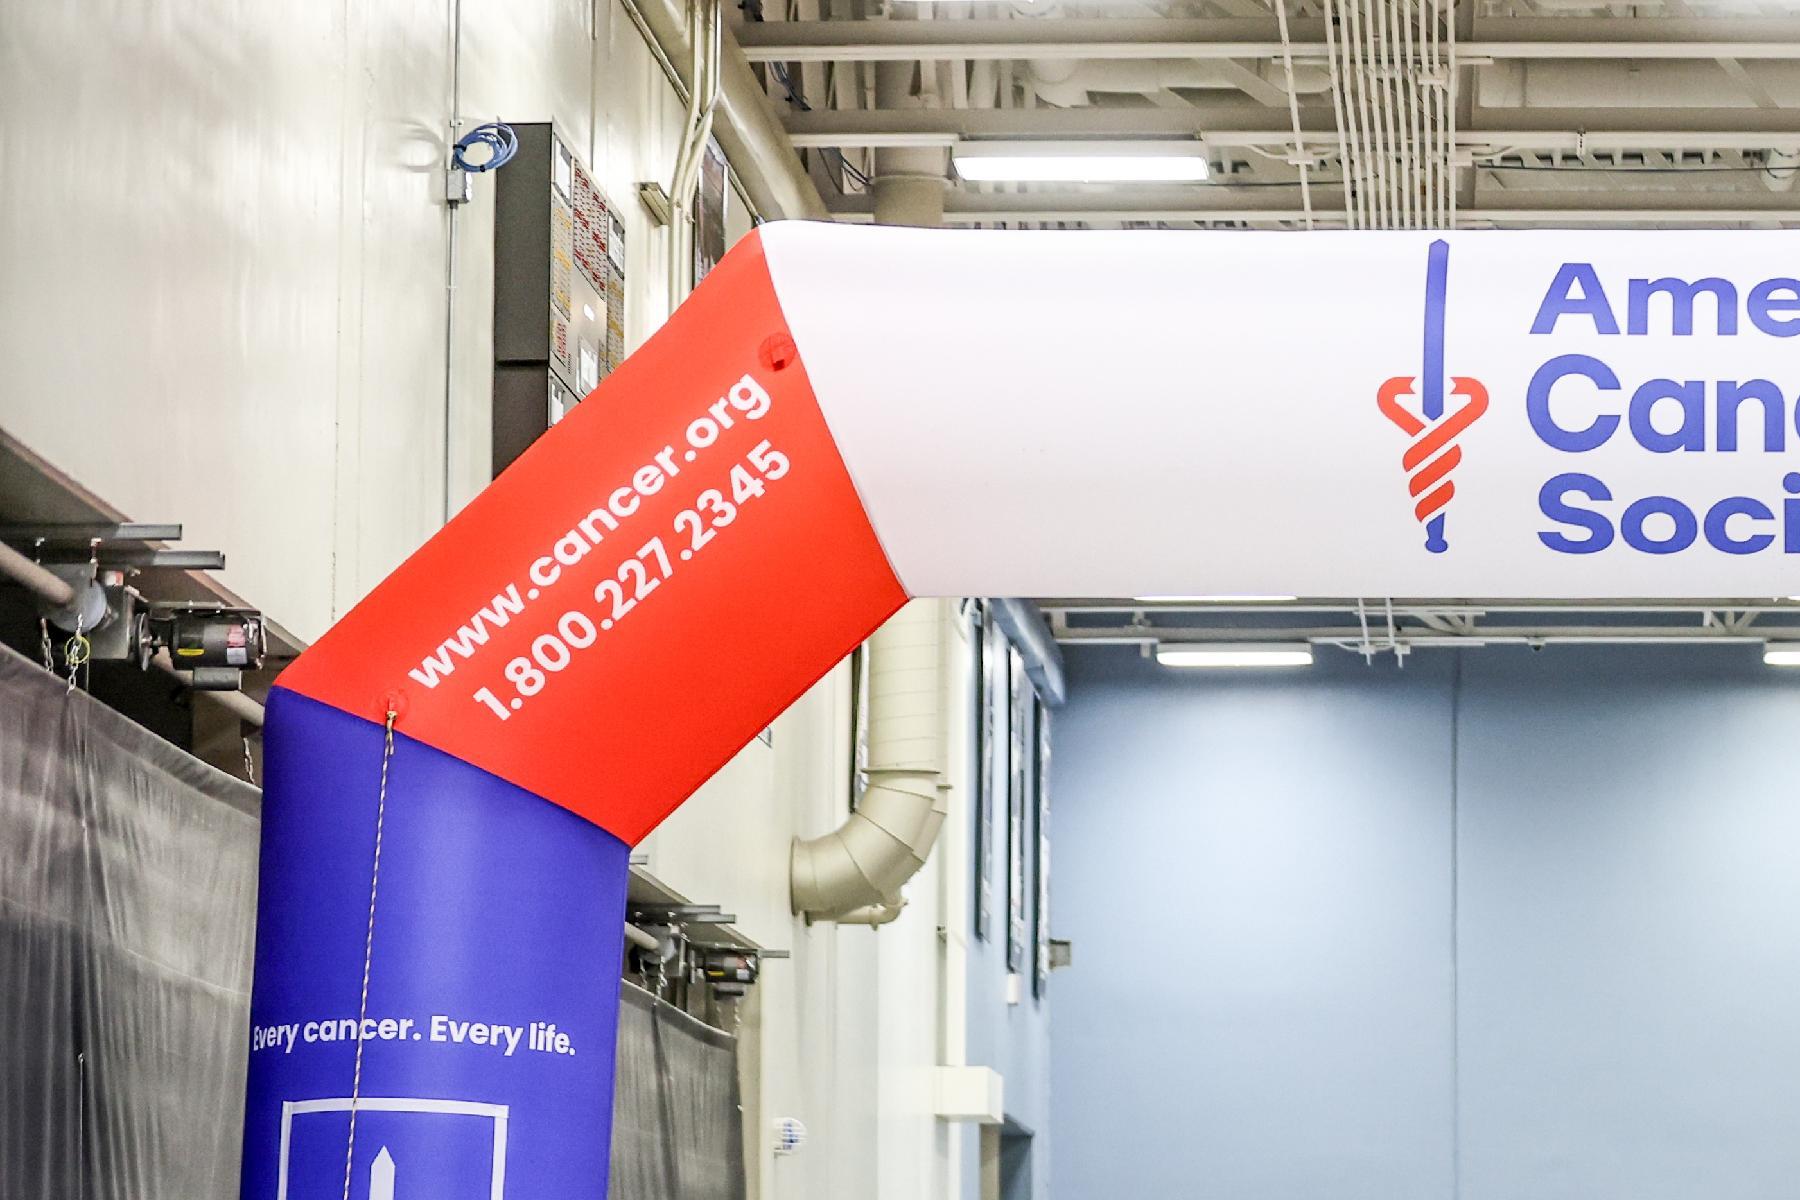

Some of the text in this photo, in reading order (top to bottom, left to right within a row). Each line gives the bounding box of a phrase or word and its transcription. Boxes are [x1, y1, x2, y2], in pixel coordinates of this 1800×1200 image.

[408, 373, 771, 690] www.cancer.org
[473, 439, 791, 721] 1.800.227.2345
[253, 1015, 576, 1056] Every cancer. Every life.
